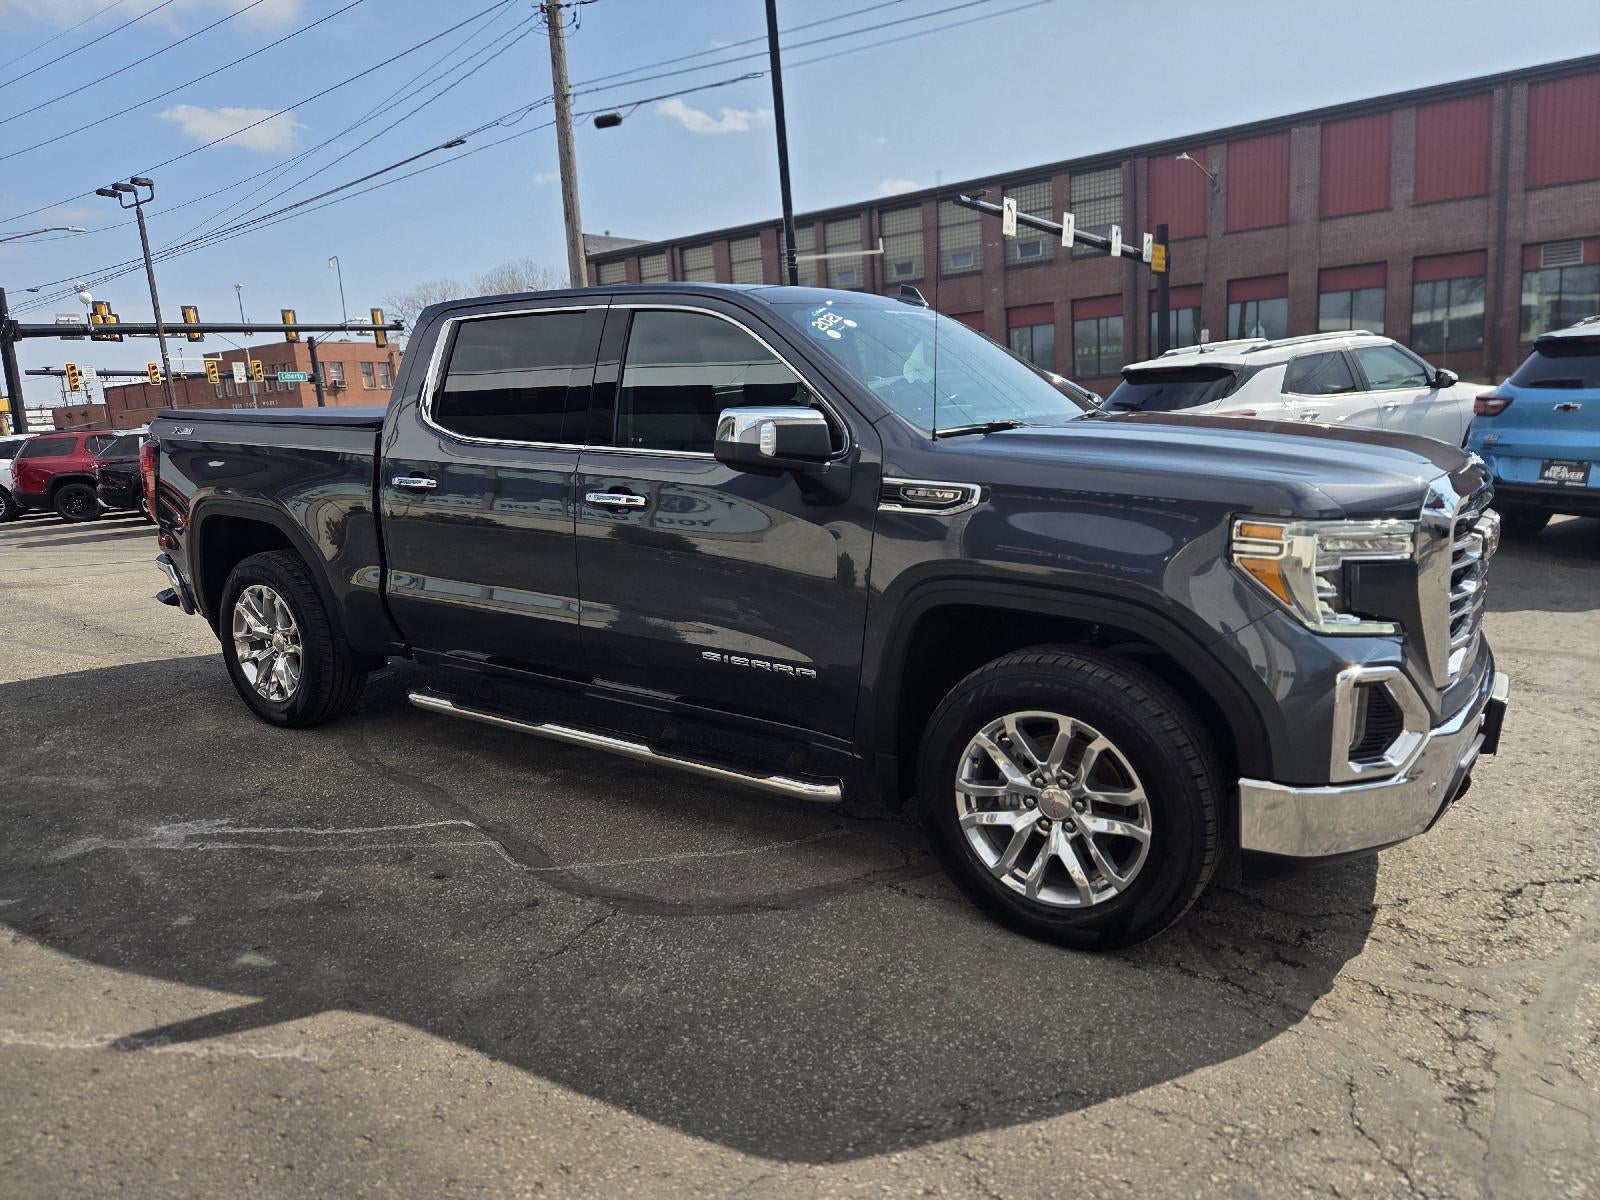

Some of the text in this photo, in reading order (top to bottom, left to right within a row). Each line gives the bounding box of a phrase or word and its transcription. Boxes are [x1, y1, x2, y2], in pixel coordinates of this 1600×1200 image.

[811, 312, 843, 331] 2021
[1544, 469, 1584, 480] WEAVER
[936, 491, 954, 499] V8
[702, 651, 817, 679] SIERRA
